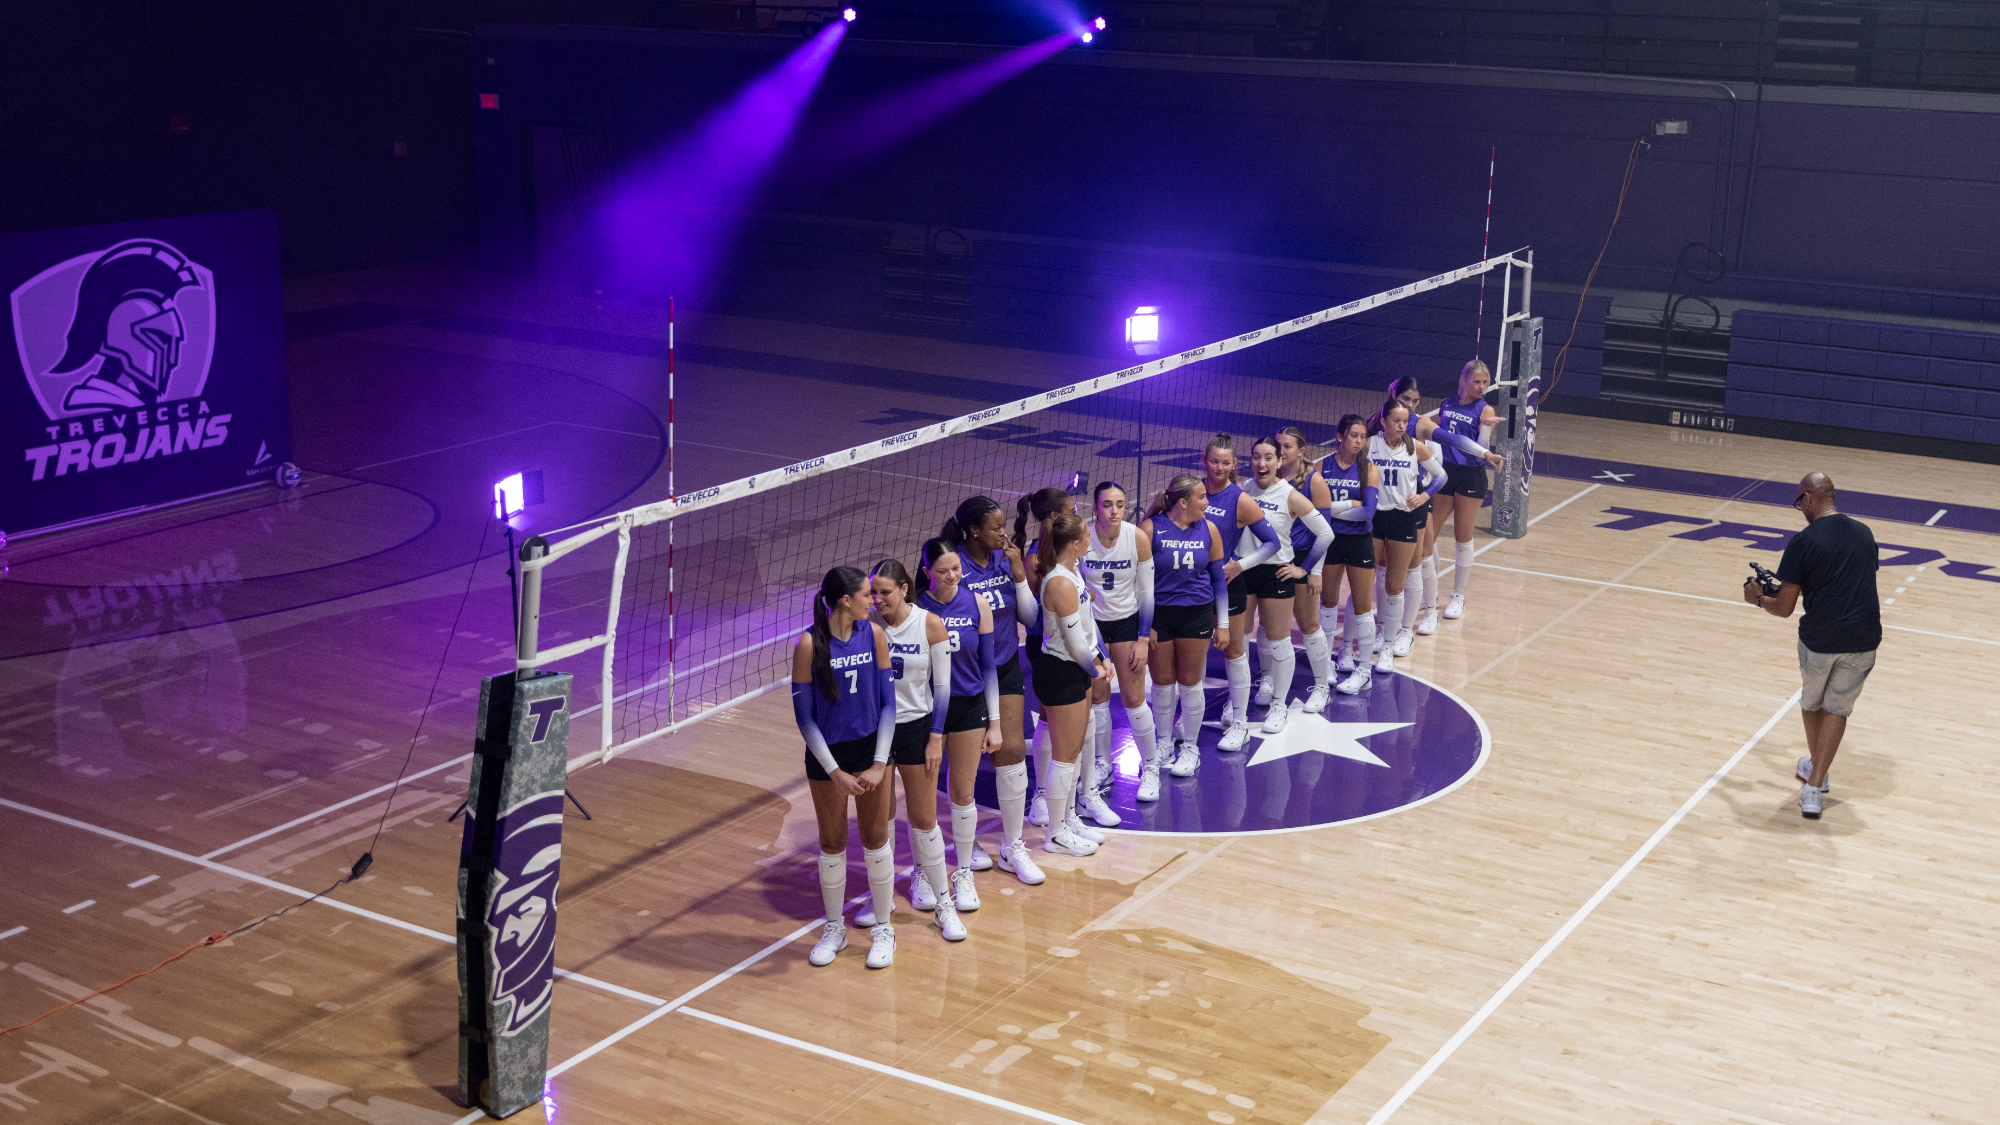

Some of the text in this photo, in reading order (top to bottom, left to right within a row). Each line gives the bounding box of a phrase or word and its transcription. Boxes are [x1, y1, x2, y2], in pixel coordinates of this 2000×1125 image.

[1533, 326, 1542, 351] T
[1116, 365, 1144, 379] TREVECCA
[1045, 385, 1076, 400] TREVECCA
[46, 400, 210, 440] TREVECCA
[968, 407, 1001, 423] TREVECCA
[1443, 410, 1473, 424] TREVECCA
[1447, 420, 1458, 434] 5
[25, 413, 232, 481] TROJANS
[881, 431, 918, 448] TREVECCA
[783, 457, 825, 476] TREVECCA
[1373, 459, 1411, 469] TREVECCA
[1383, 468, 1398, 487] 11
[675, 487, 720, 507] TREVECCA
[1332, 488, 1349, 501] 12
[1205, 504, 1226, 517] ECCA
[1161, 539, 1204, 549] TREVECCA
[1085, 559, 1131, 570] TREVECCA
[1172, 550, 1195, 570] 14
[968, 574, 1010, 591] TREVECCA
[1102, 571, 1115, 591] 3
[982, 588, 1006, 611] 21
[941, 616, 973, 627] VECCA
[887, 643, 921, 655] VECCA
[948, 630, 961, 652] 3
[830, 651, 873, 669] REVECCA
[844, 668, 858, 694] 7
[528, 695, 566, 744] T
